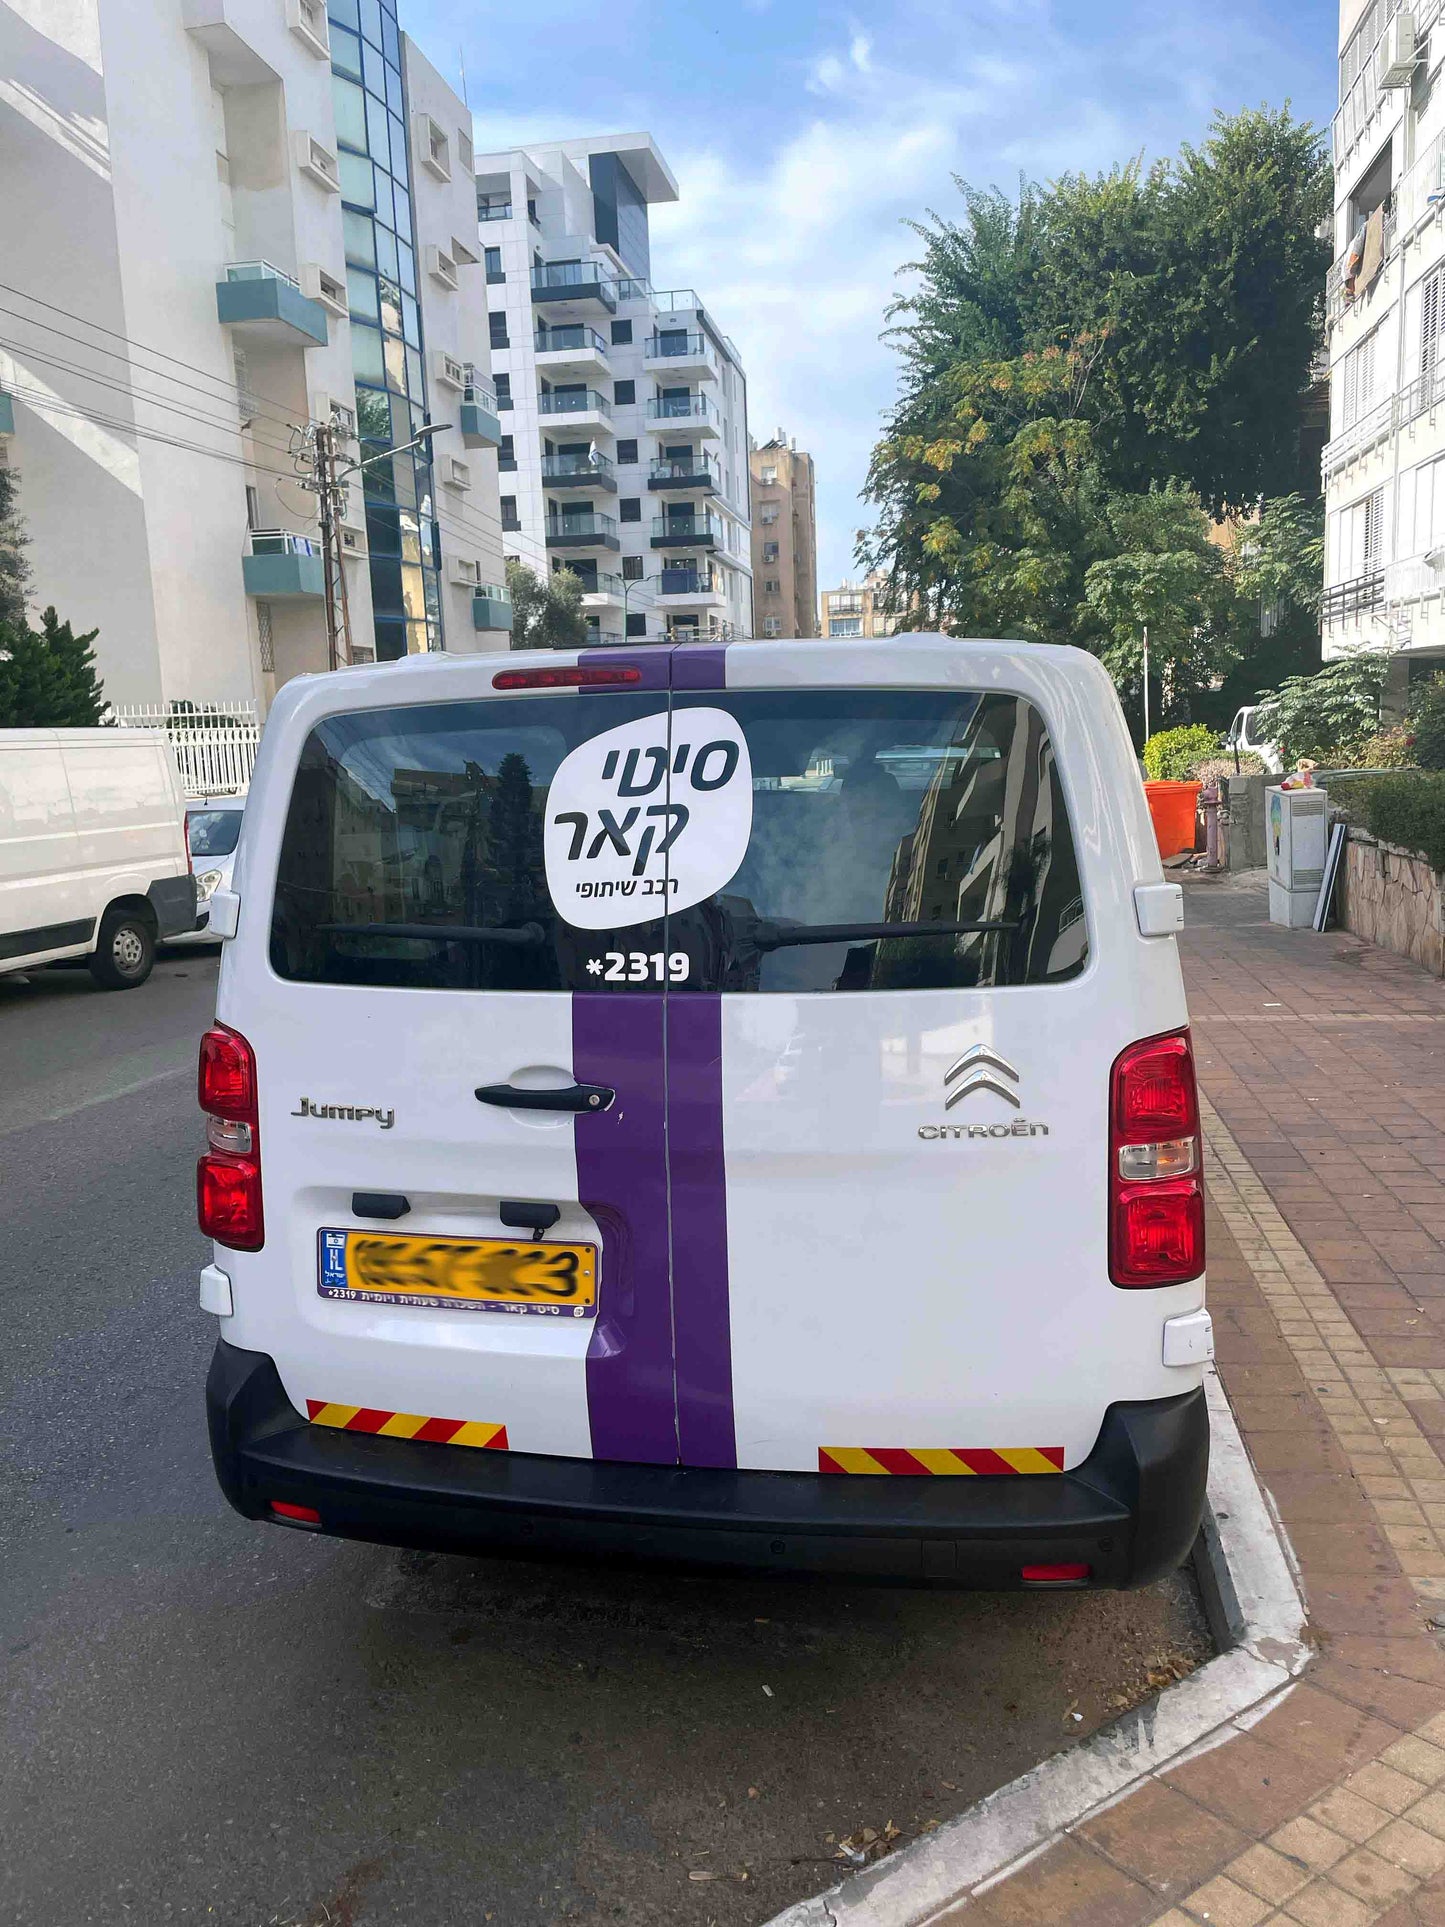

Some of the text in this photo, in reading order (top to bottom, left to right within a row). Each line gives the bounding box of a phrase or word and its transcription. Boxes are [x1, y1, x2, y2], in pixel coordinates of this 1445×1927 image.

[602, 740, 739, 797] סיטי
[554, 803, 690, 876] קאר
[575, 878, 679, 898] רכב שיתופי
[290, 1097, 395, 1130] Jumpy
[330, 1248, 343, 1270] IL
